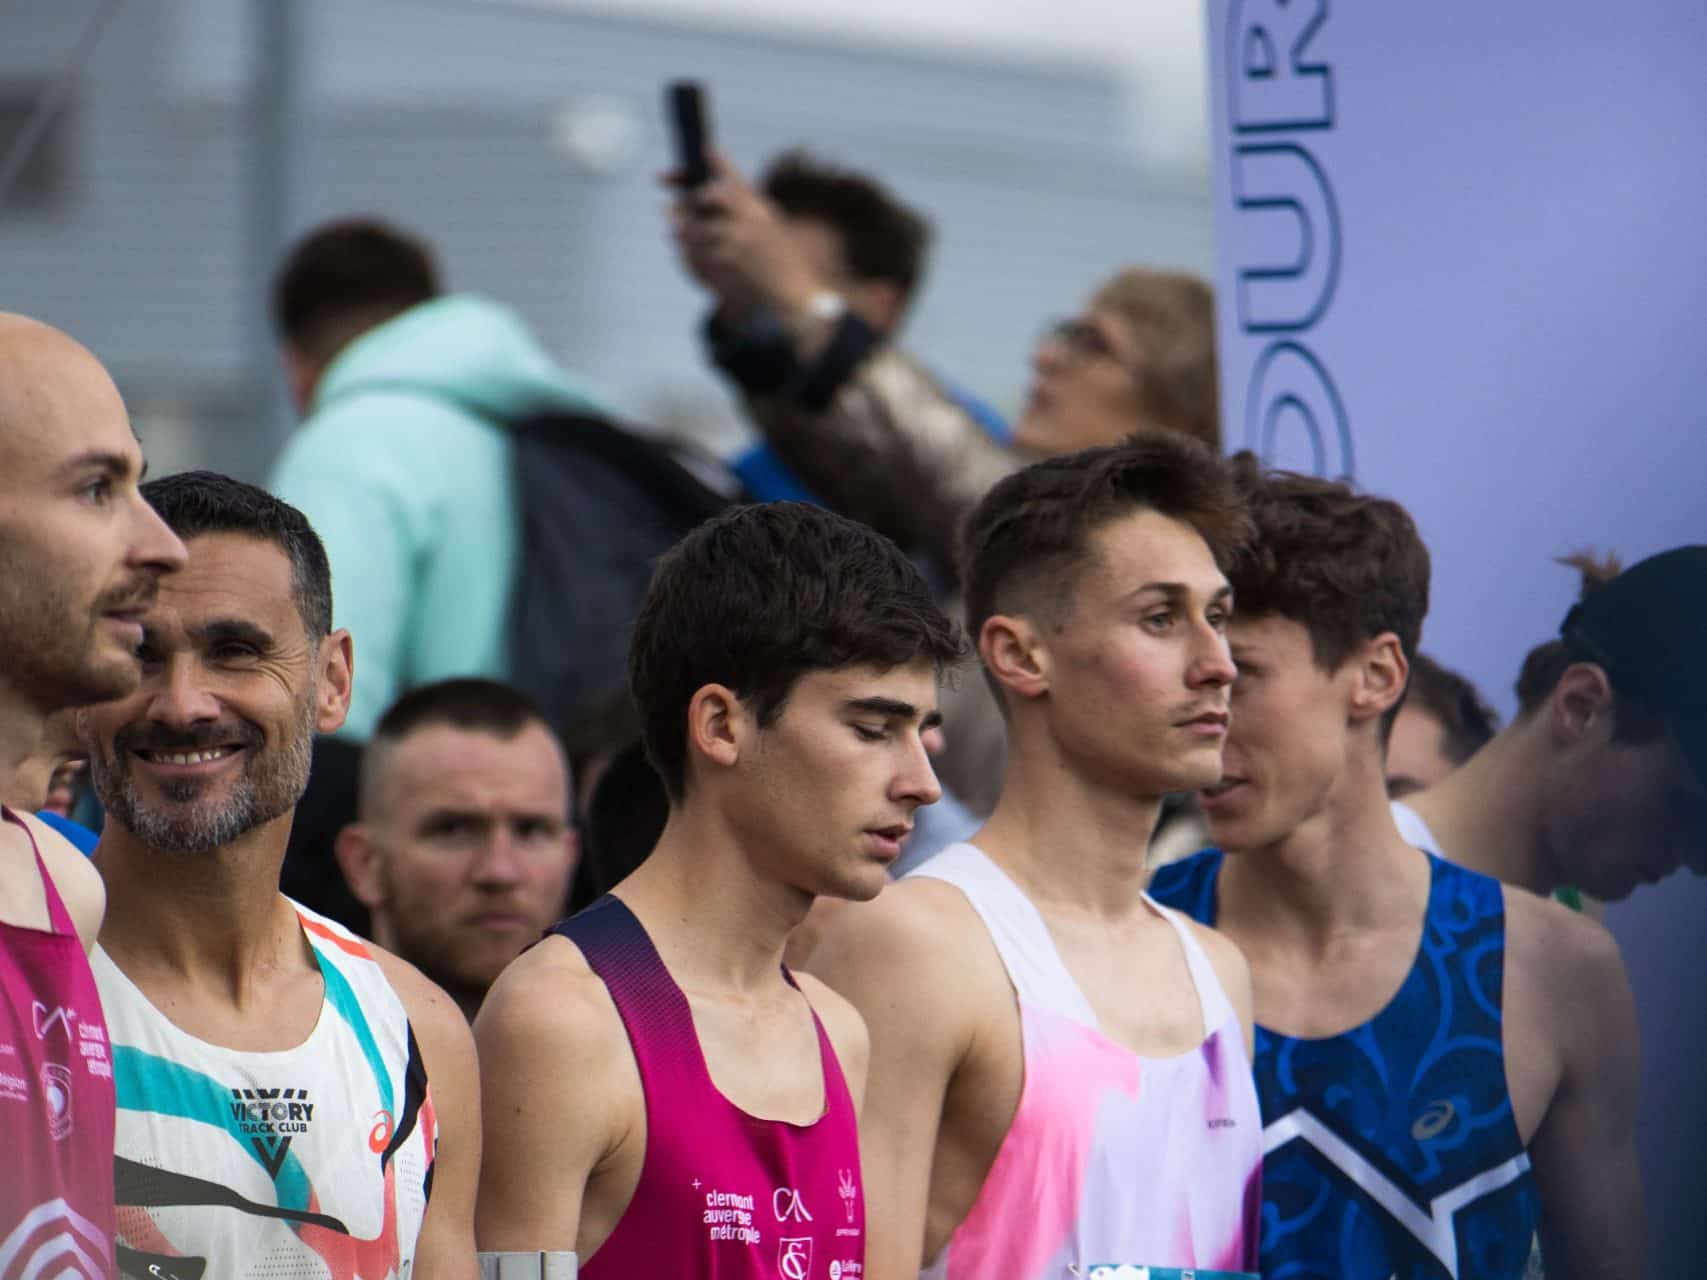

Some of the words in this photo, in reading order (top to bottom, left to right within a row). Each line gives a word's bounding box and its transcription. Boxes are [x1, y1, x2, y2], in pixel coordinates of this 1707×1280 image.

[230, 1102, 314, 1122] VICTORY
[239, 1122, 274, 1133] TRACK
[279, 1122, 308, 1133] CLUB
